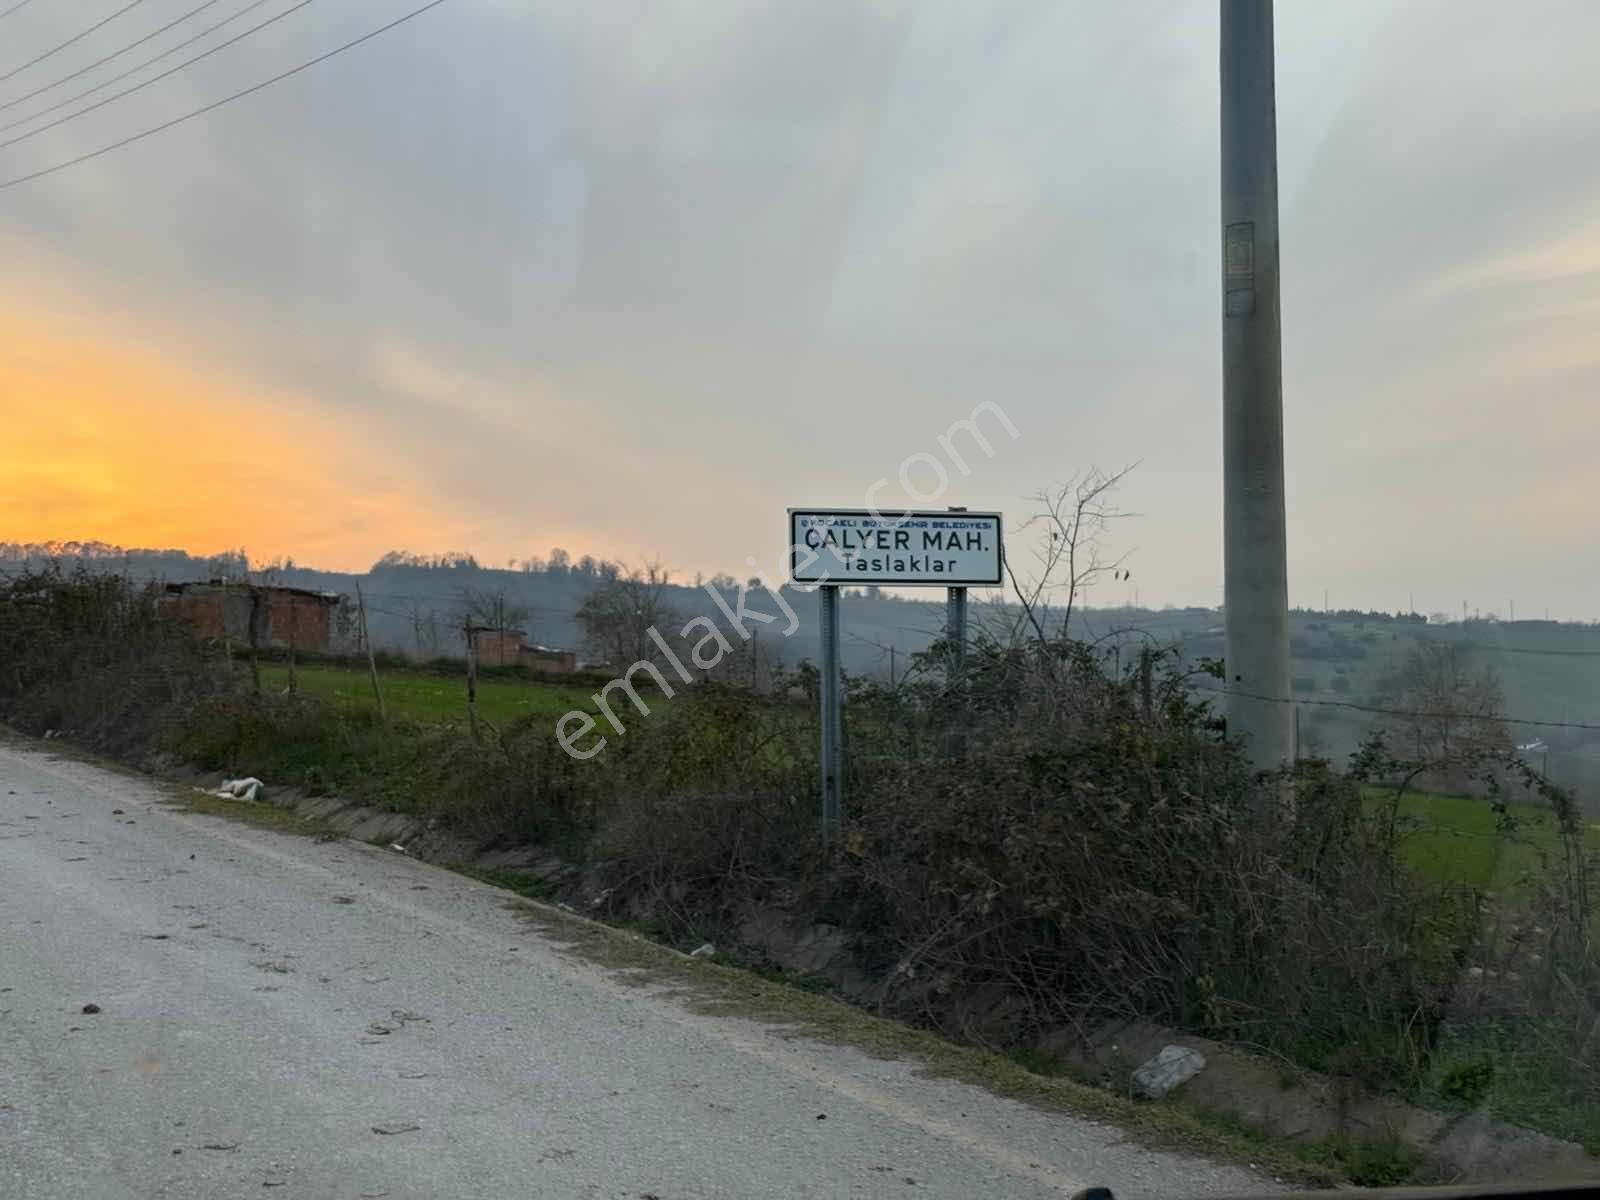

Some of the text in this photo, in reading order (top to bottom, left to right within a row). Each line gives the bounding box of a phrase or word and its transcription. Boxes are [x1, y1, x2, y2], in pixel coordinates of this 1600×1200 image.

[805, 529, 990, 551] ÇALYER MAH.
[842, 553, 957, 573] Taslaklar
